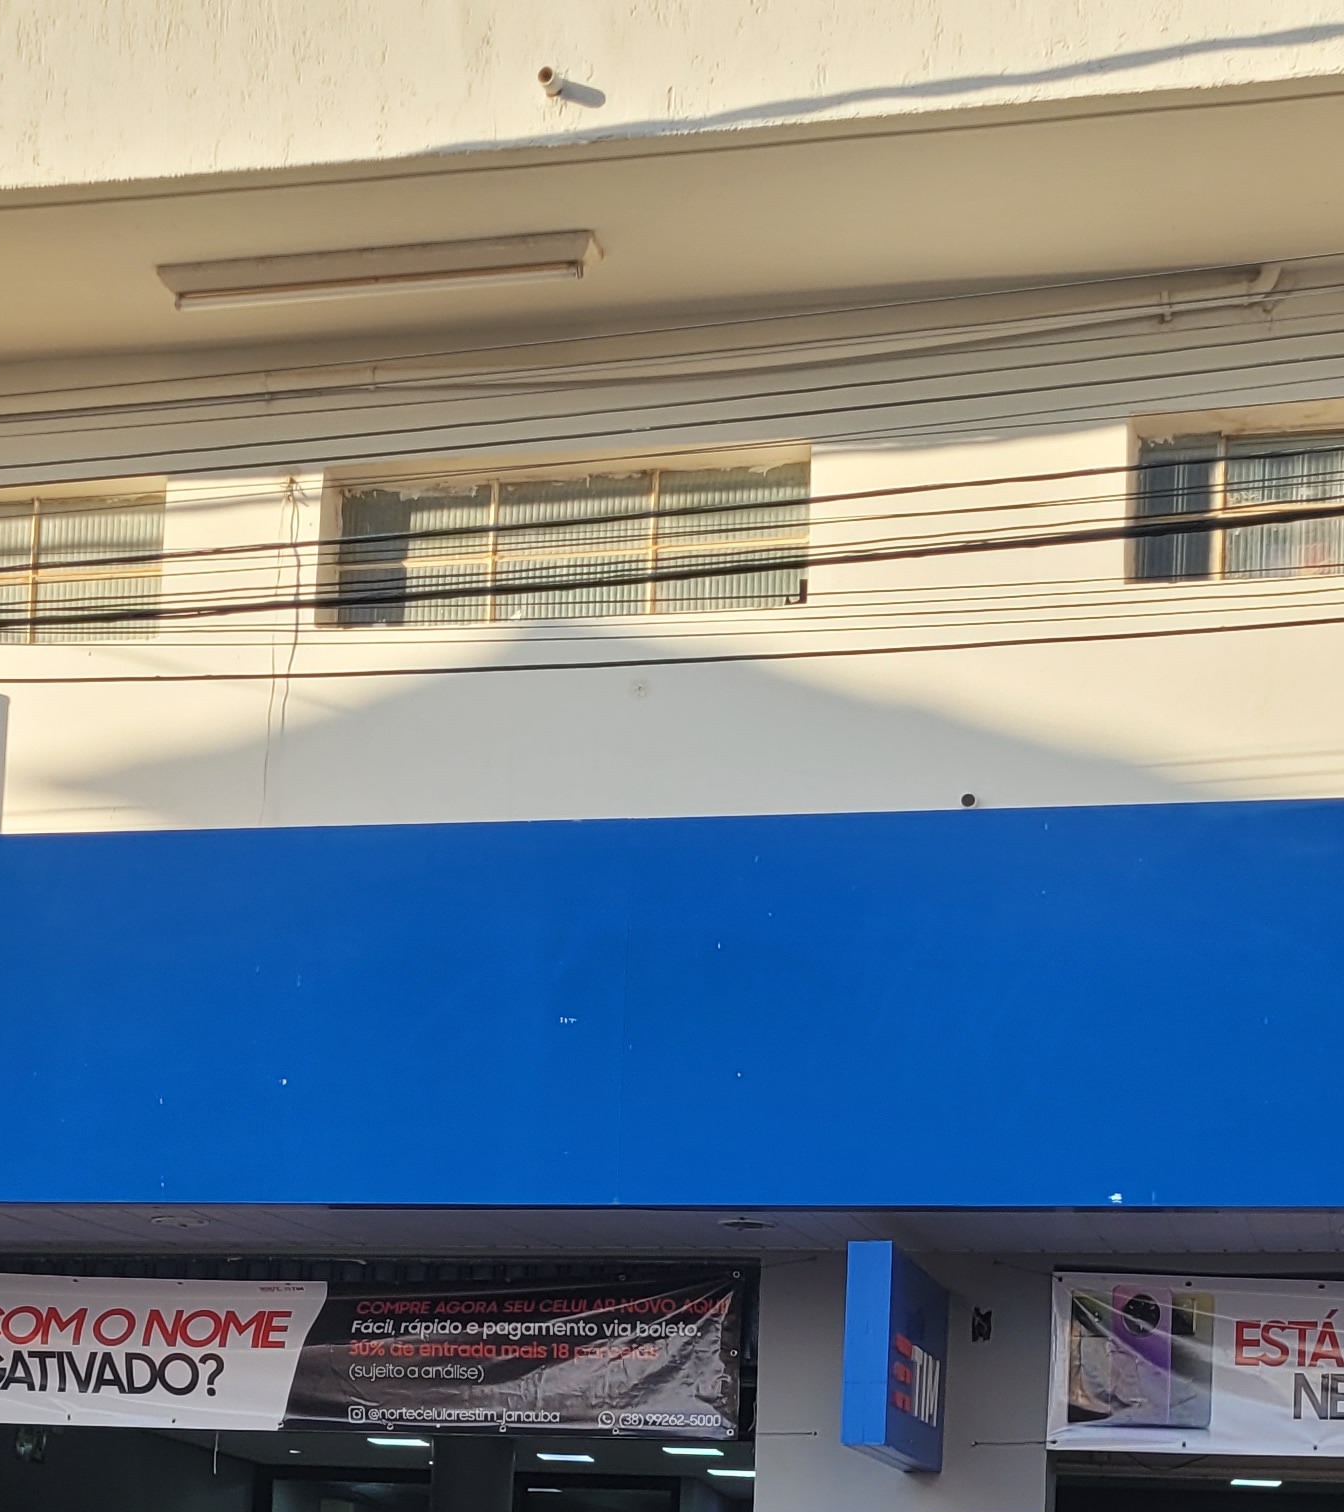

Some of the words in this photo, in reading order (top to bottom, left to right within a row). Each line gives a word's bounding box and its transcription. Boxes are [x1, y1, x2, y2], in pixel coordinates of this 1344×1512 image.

[356, 1300, 431, 1315] COMPRE
[434, 1300, 498, 1314] AGORA
[503, 1300, 535, 1313] SEU
[539, 1298, 615, 1313] CELULAR
[620, 1298, 676, 1315] NOVO
[93, 1307, 136, 1347] O
[142, 1309, 292, 1349] NOME
[351, 1318, 396, 1336] Fácil,
[400, 1319, 462, 1340] rápido
[466, 1322, 479, 1334] e
[483, 1319, 598, 1340] pagamento
[603, 1319, 632, 1337] via
[636, 1320, 702, 1337] boleto.
[1234, 1309, 1344, 1367] ESTÁ
[390, 1341, 414, 1357] de
[419, 1341, 496, 1358] entrada
[501, 1341, 548, 1359] mais
[551, 1343, 569, 1359] 18
[574, 1343, 660, 1364] parcelas
[348, 1363, 405, 1381] (sujeito
[407, 1367, 419, 1378] a
[421, 1364, 484, 1382] análise)
[911, 1344, 940, 1427] TIM
[368, 1406, 560, 1425] @nortecelularestim_janauba
[619, 1413, 645, 1428] (38)
[646, 1413, 722, 1426] 99262-5000
